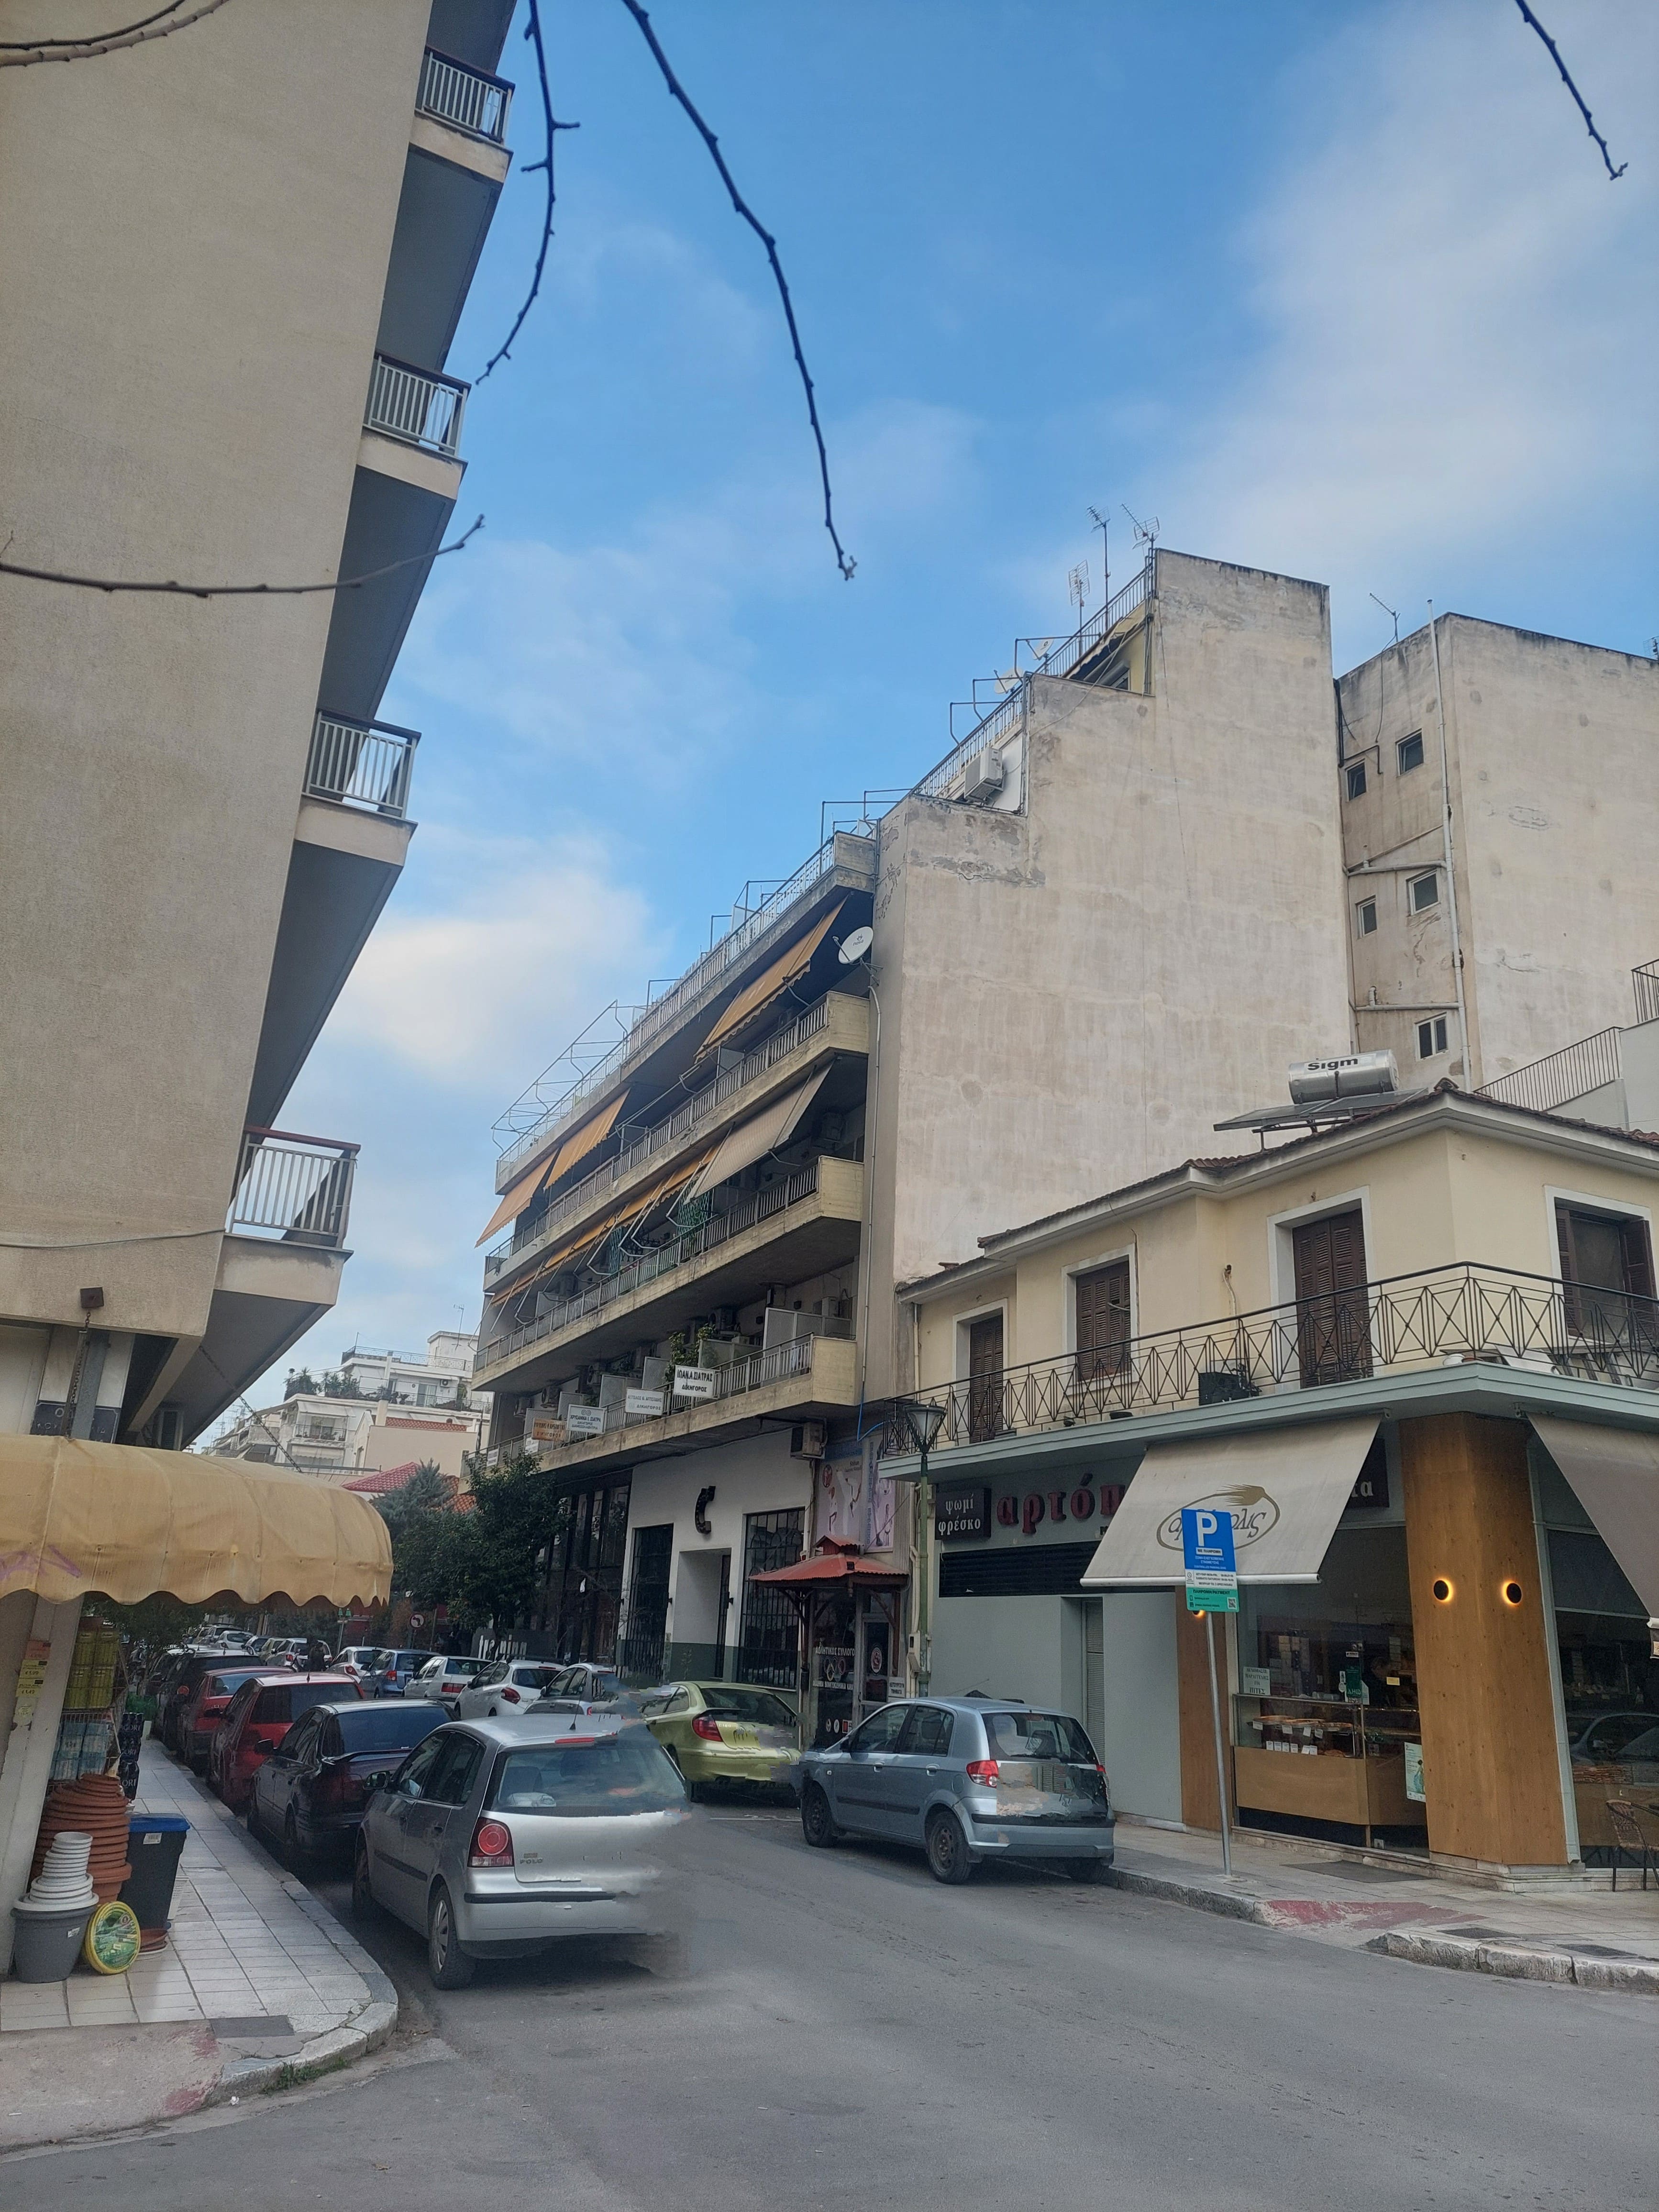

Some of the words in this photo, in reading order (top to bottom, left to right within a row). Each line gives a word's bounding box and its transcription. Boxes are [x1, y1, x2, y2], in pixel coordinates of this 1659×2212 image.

[1307, 1058, 1358, 1070] Sigm
[682, 1384, 707, 1392] ΔΙΚΗΓΟΡΟΣ
[945, 1493, 974, 1515] ψωμί
[996, 1473, 1126, 1534] αρτόπ
[938, 1516, 981, 1536] φρέσκο
[1196, 1512, 1217, 1546] P
[838, 1648, 855, 1657] ΣΥΛΛΟΓΟ
[121, 1723, 141, 1731] GORI
